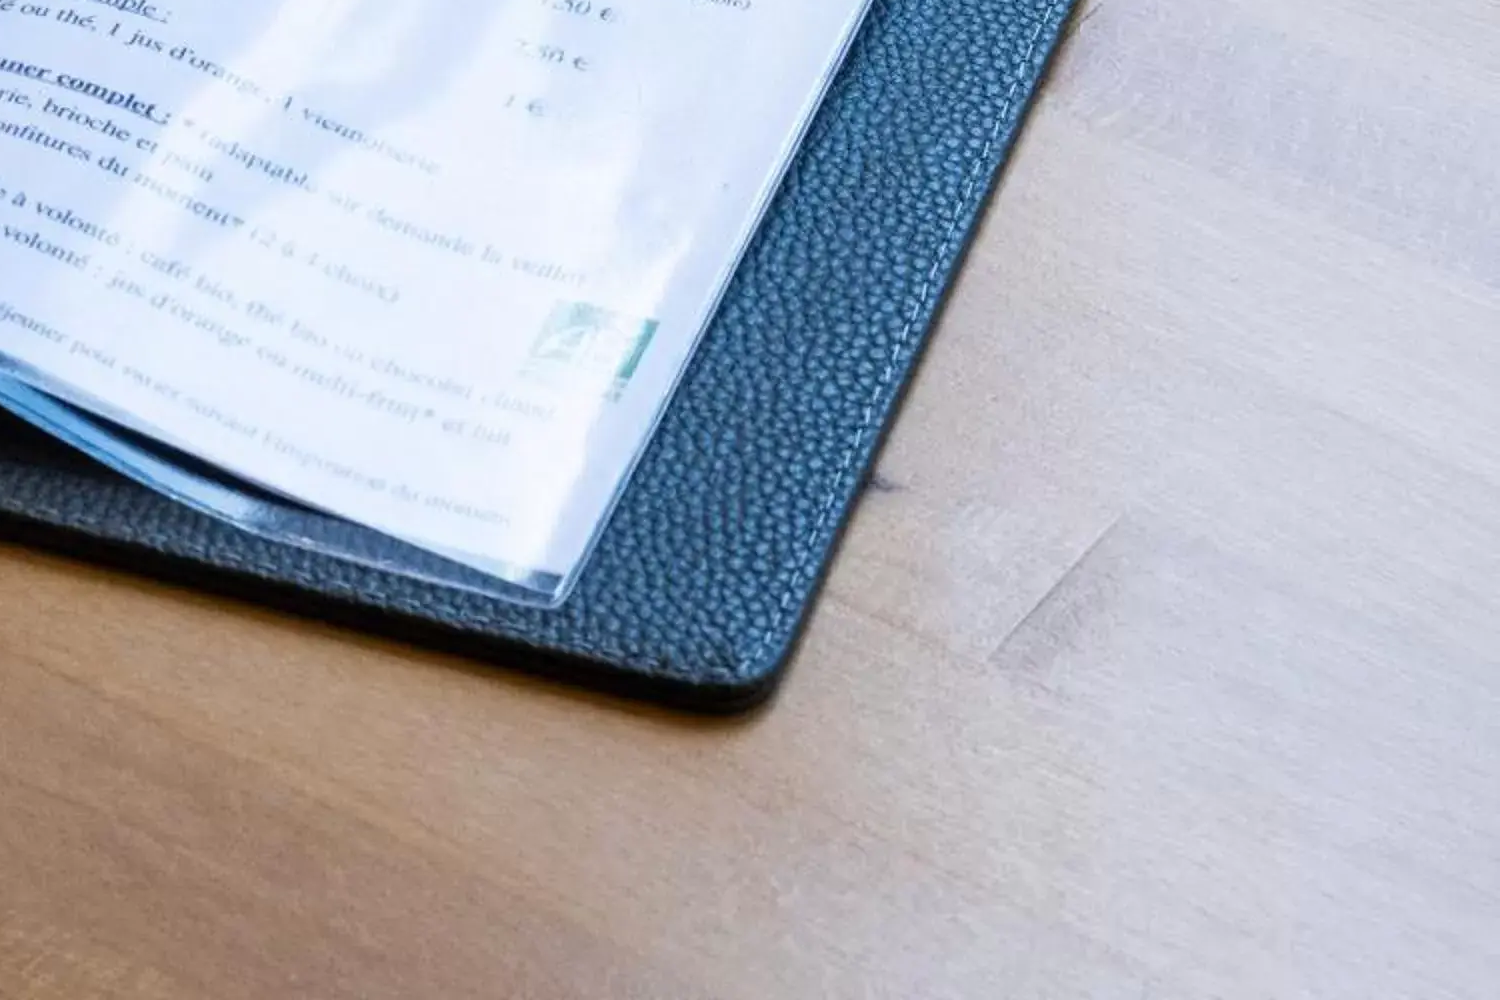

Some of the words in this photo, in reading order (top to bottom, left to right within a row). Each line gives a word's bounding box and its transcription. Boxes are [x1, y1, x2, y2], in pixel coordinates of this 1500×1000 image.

[598, 6, 622, 23] €
[19, 3, 51, 19] ou
[55, 8, 98, 33] thé,
[107, 21, 122, 38] 1
[124, 26, 163, 54] jus
[282, 94, 294, 112] 1
[55, 68, 159, 122] complet
[41, 98, 132, 142] brioche
[136, 138, 159, 156] et
[97, 155, 131, 179] du
[1, 226, 89, 272] volonté
[10, 190, 29, 209] à
[35, 199, 122, 247] volonté
[139, 249, 193, 281] café
